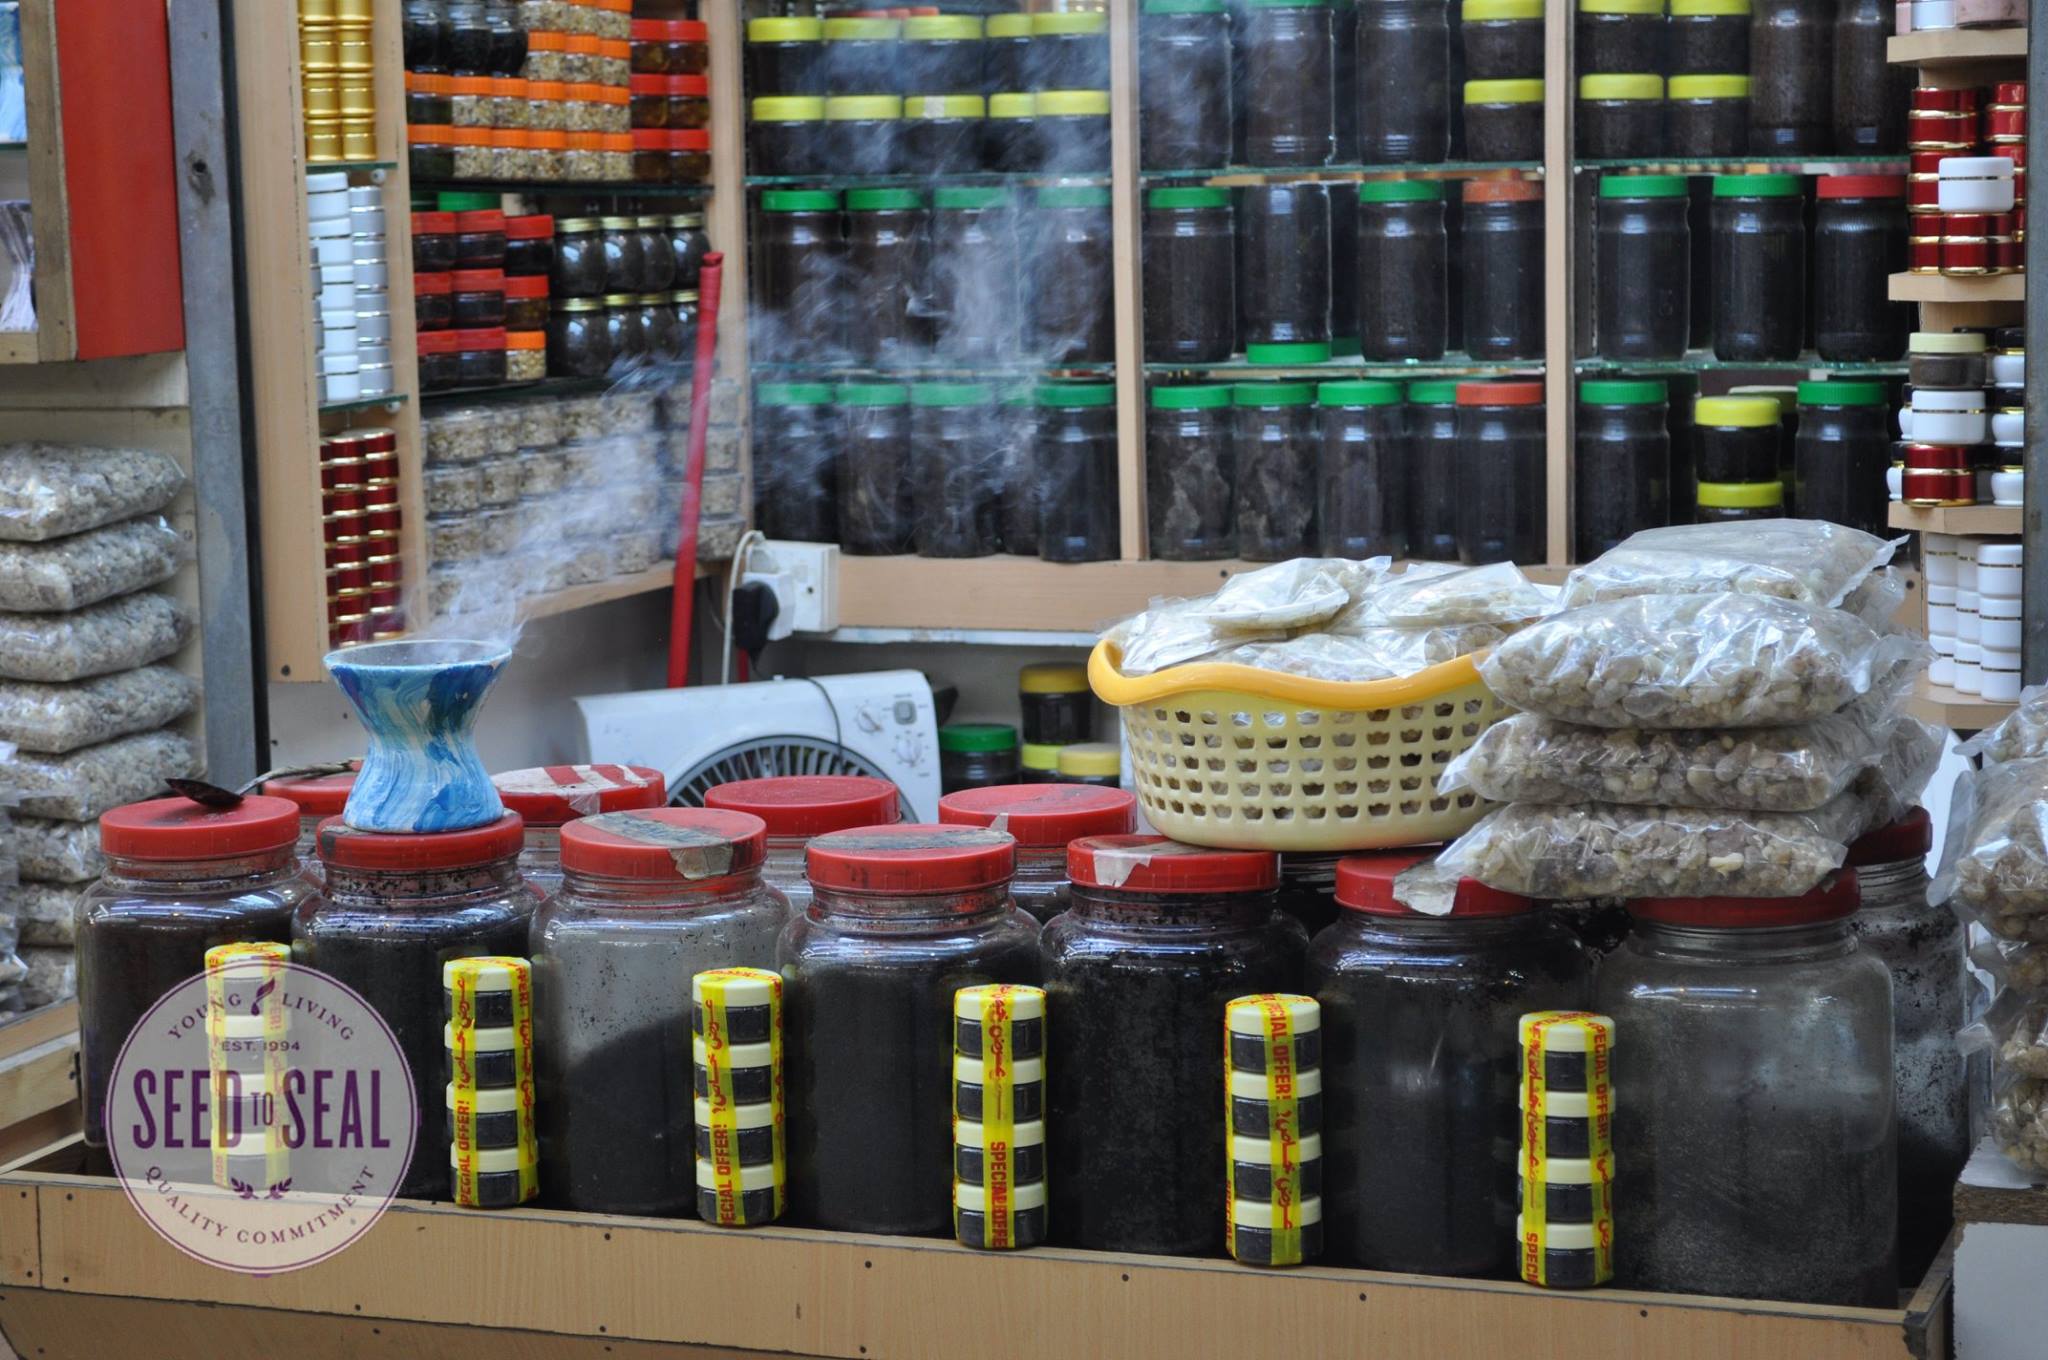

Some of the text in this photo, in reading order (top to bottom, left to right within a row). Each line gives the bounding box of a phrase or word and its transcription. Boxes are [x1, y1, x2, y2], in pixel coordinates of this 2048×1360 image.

[1272, 1049, 1291, 1100] OFFER!
[458, 1101, 471, 1206] PECIAL OFFER!
[713, 1124, 731, 1175] OFFER!
